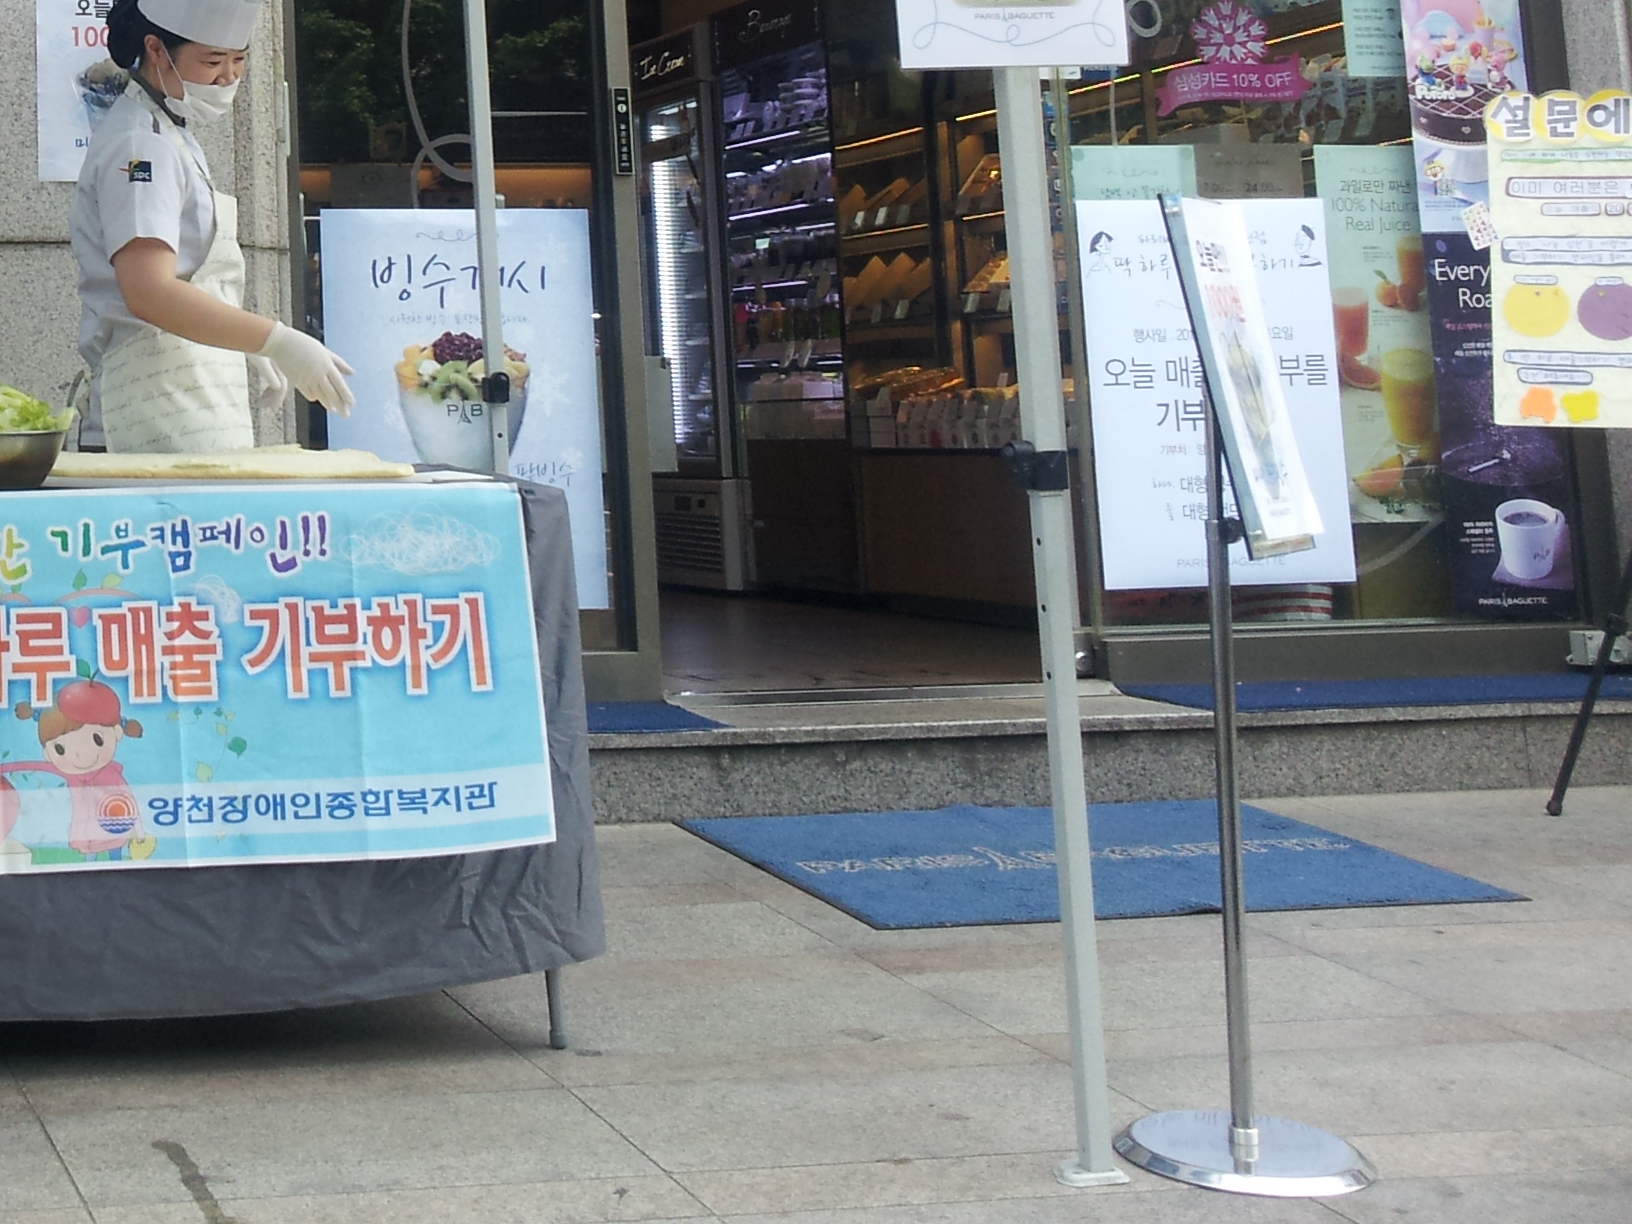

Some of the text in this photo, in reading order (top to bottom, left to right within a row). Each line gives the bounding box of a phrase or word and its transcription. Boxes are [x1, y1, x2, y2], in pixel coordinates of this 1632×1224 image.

[974, 11, 1055, 21] PARIS BAGUETTE
[1174, 71, 1292, 92] 삼성카드 10% OFF
[1489, 94, 1631, 139] 설문에
[1339, 179, 1384, 194] 과일로만
[1511, 180, 1619, 195] 이미 여러분은
[1331, 198, 1366, 213] 100%
[1345, 217, 1411, 234] Real Juice
[1113, 253, 1294, 280] 딱 하루 하기
[1434, 258, 1491, 287] Every
[1133, 327, 1167, 343] 행사일
[1267, 326, 1294, 341] 요일
[1103, 354, 1157, 389] 오늘
[446, 403, 483, 417] P B
[1478, 596, 1548, 606] PARIS BAGUETTE
[96, 596, 222, 703] 매출
[242, 591, 494, 699] 기부하기
[146, 779, 500, 827] 양천장애인종합복지관
